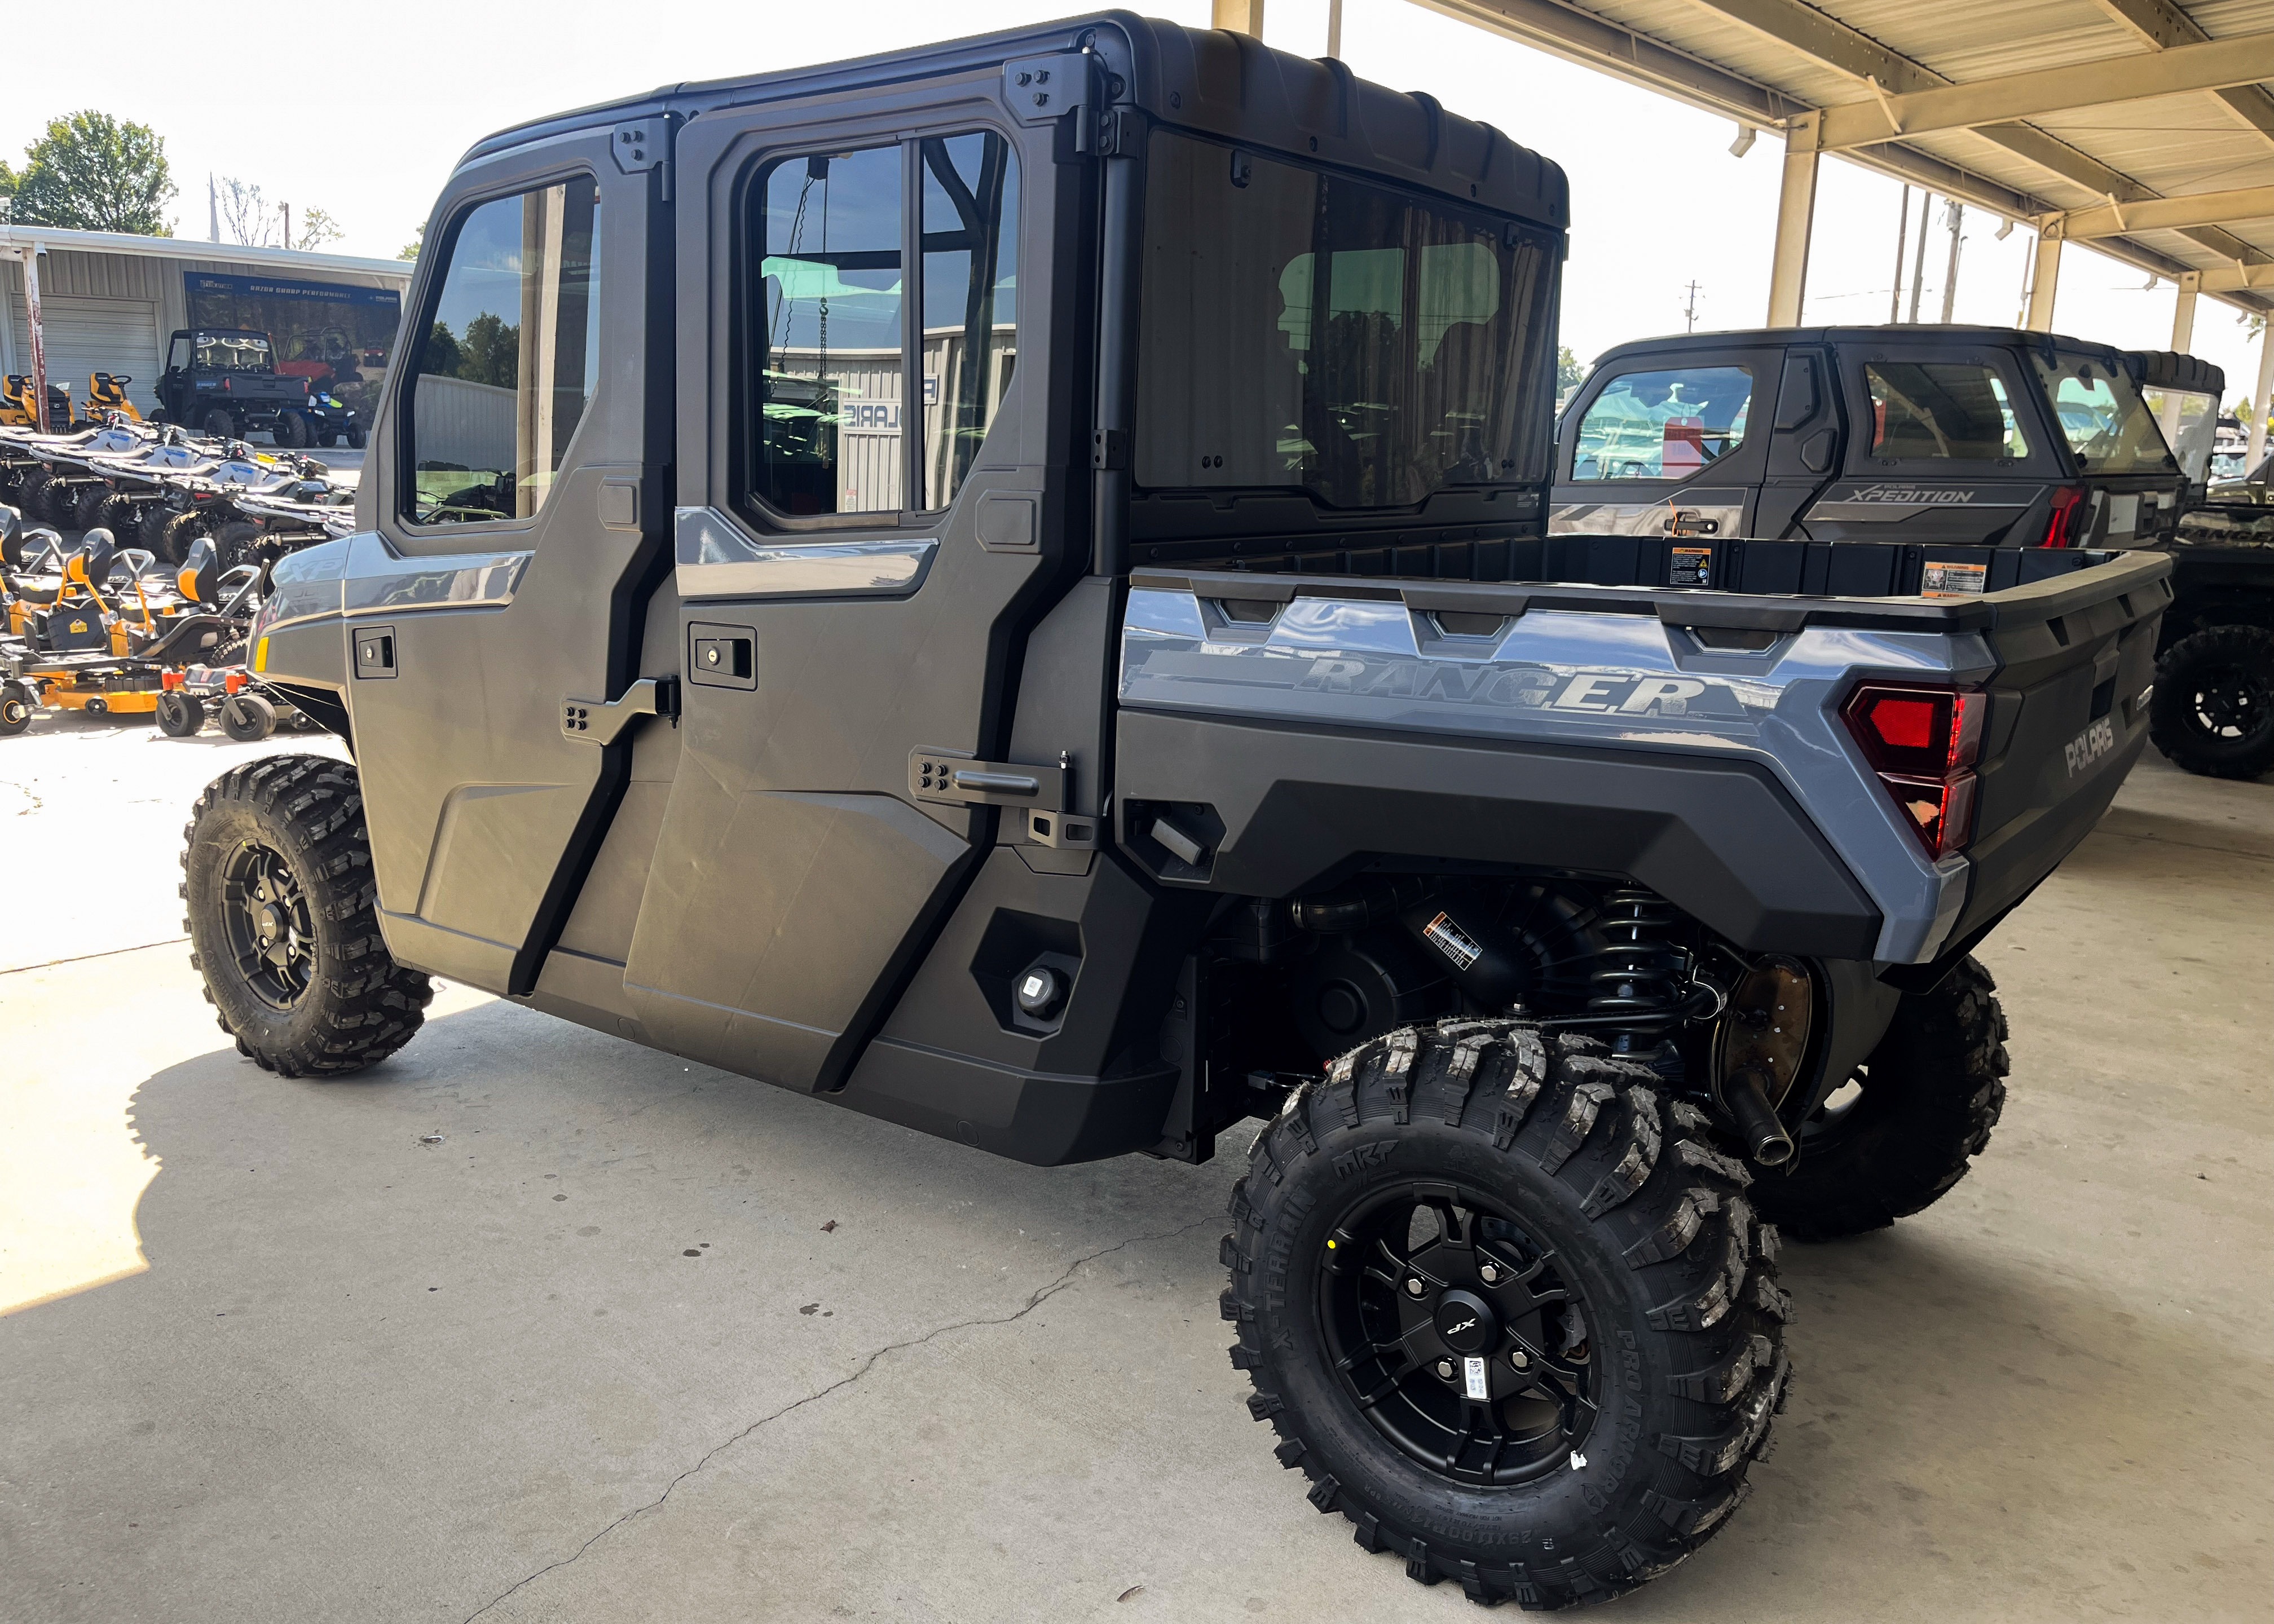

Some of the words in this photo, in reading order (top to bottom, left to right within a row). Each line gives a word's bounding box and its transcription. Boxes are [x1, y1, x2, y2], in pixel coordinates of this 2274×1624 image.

[1843, 483, 1975, 503] XPEDITION
[1292, 656, 1707, 716] RANGER
[2065, 717, 2114, 778] POLARIS
[1263, 1185, 1317, 1351] X-TERRAIN
[1447, 1318, 1476, 1335] XP
[1615, 1329, 1643, 1392] PRO
